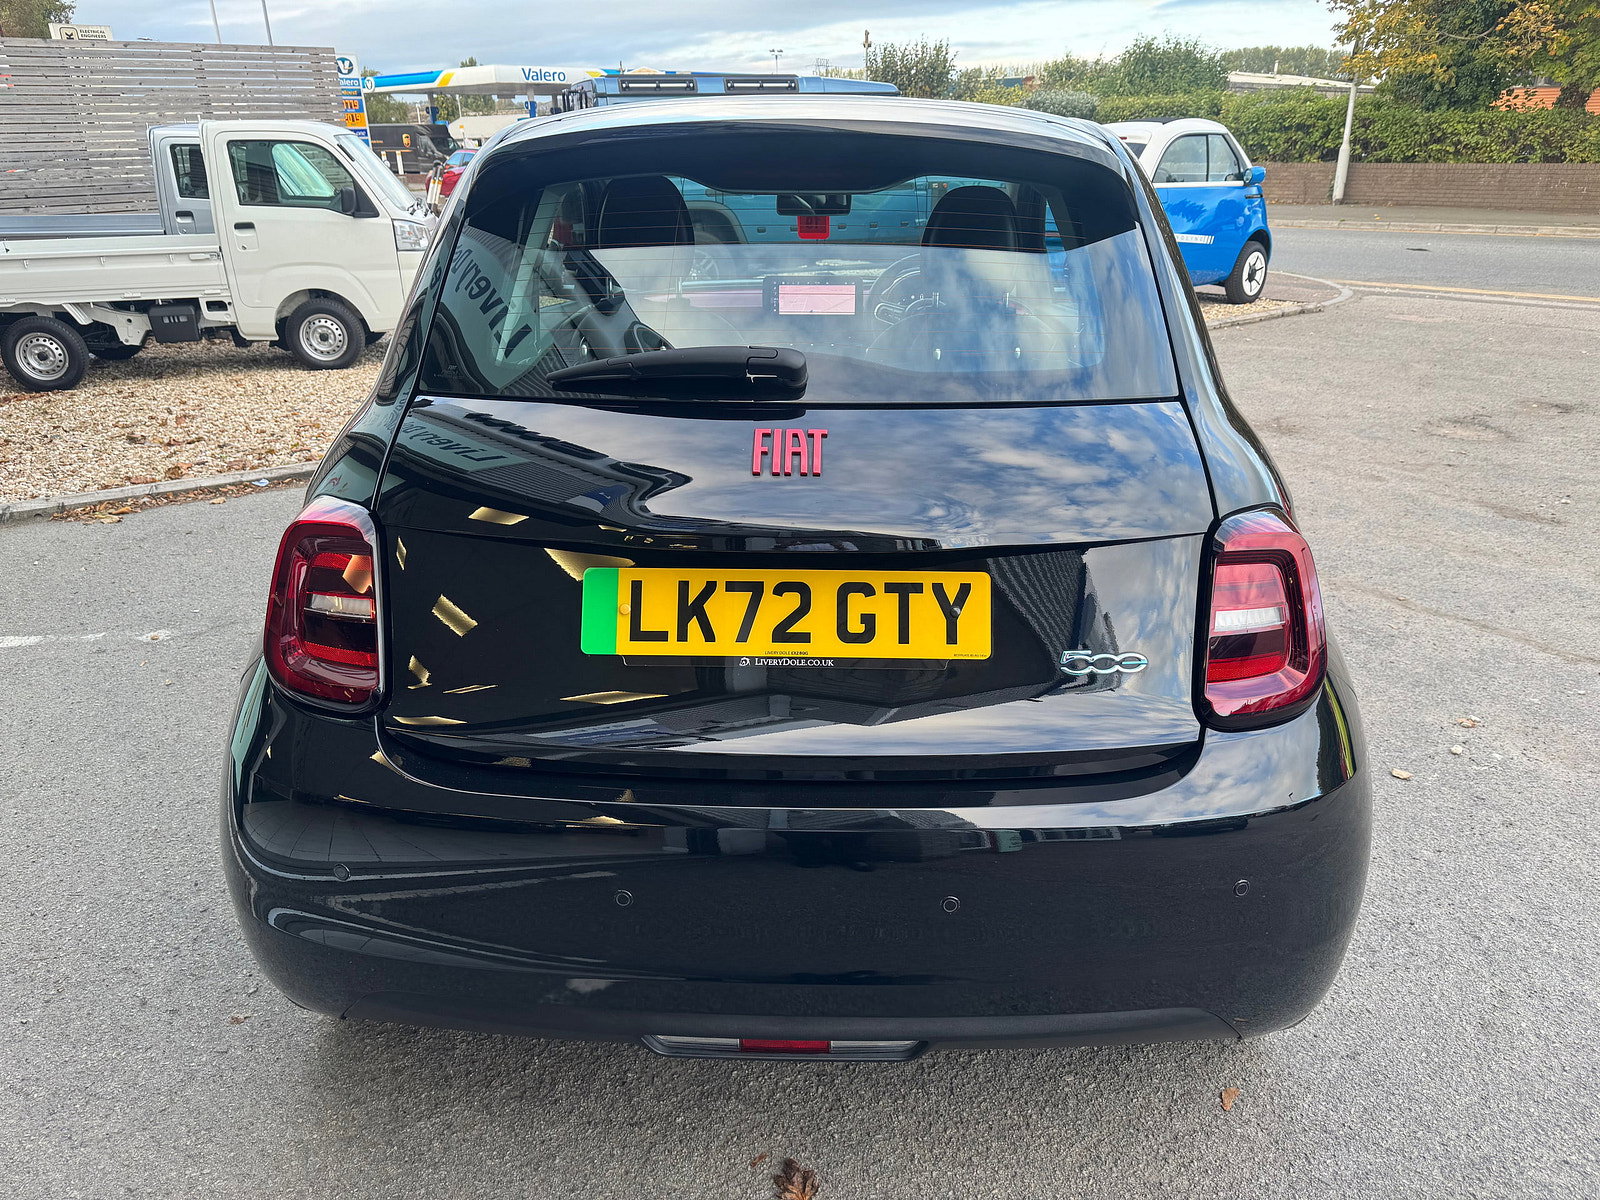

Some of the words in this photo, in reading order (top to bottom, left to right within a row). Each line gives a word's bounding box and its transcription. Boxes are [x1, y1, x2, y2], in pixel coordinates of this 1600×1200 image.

[521, 67, 566, 82] Valero
[752, 428, 828, 477] FIAT
[629, 579, 812, 643] LK72
[836, 581, 972, 645] GTY
